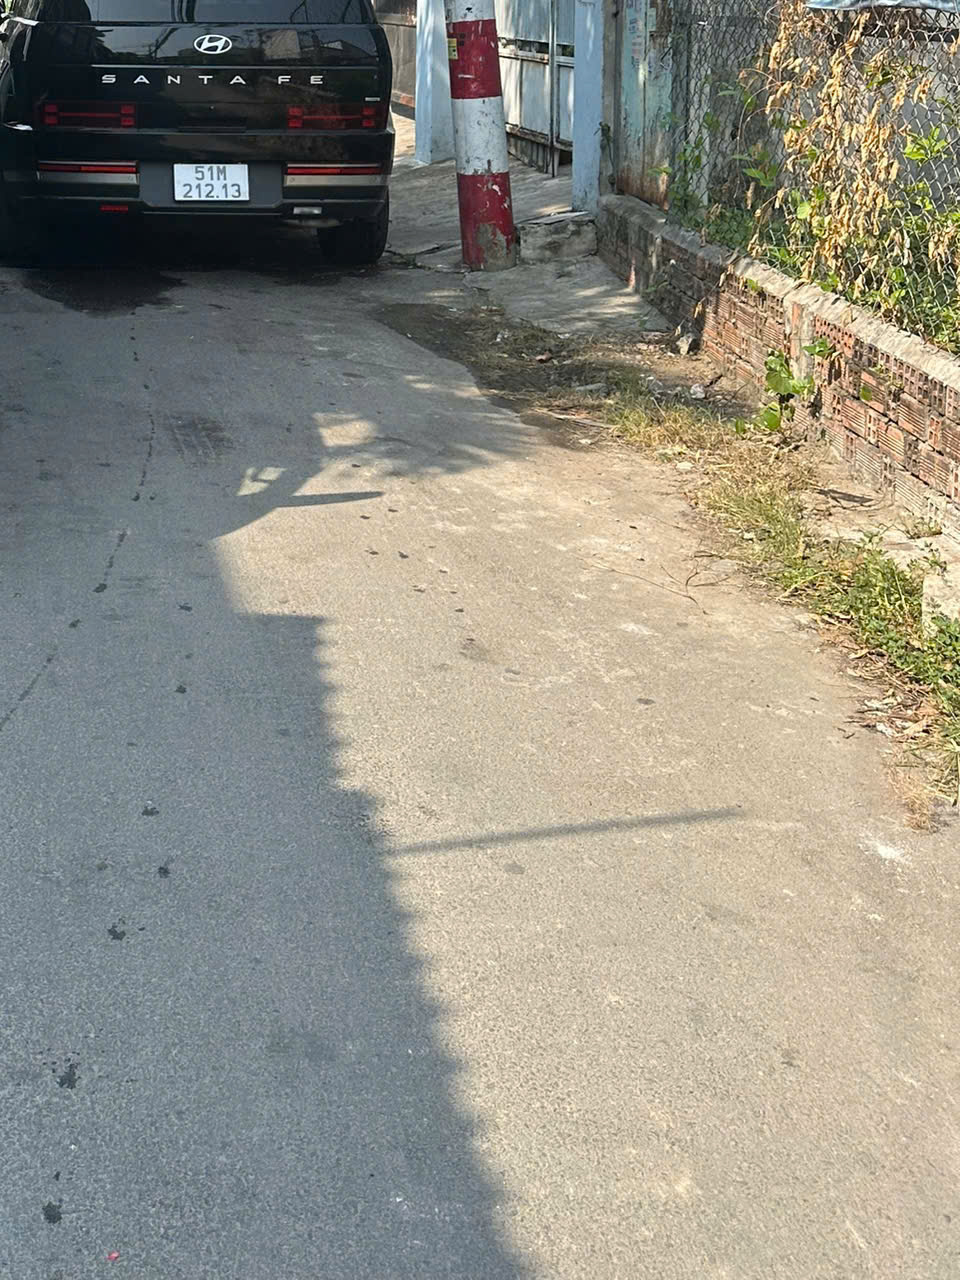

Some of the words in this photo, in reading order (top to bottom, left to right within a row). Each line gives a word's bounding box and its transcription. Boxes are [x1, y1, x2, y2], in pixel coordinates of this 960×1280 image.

[100, 74, 247, 85] SANTA
[277, 74, 324, 85] FE
[194, 165, 228, 181] 51M
[182, 183, 242, 199] 212.13
